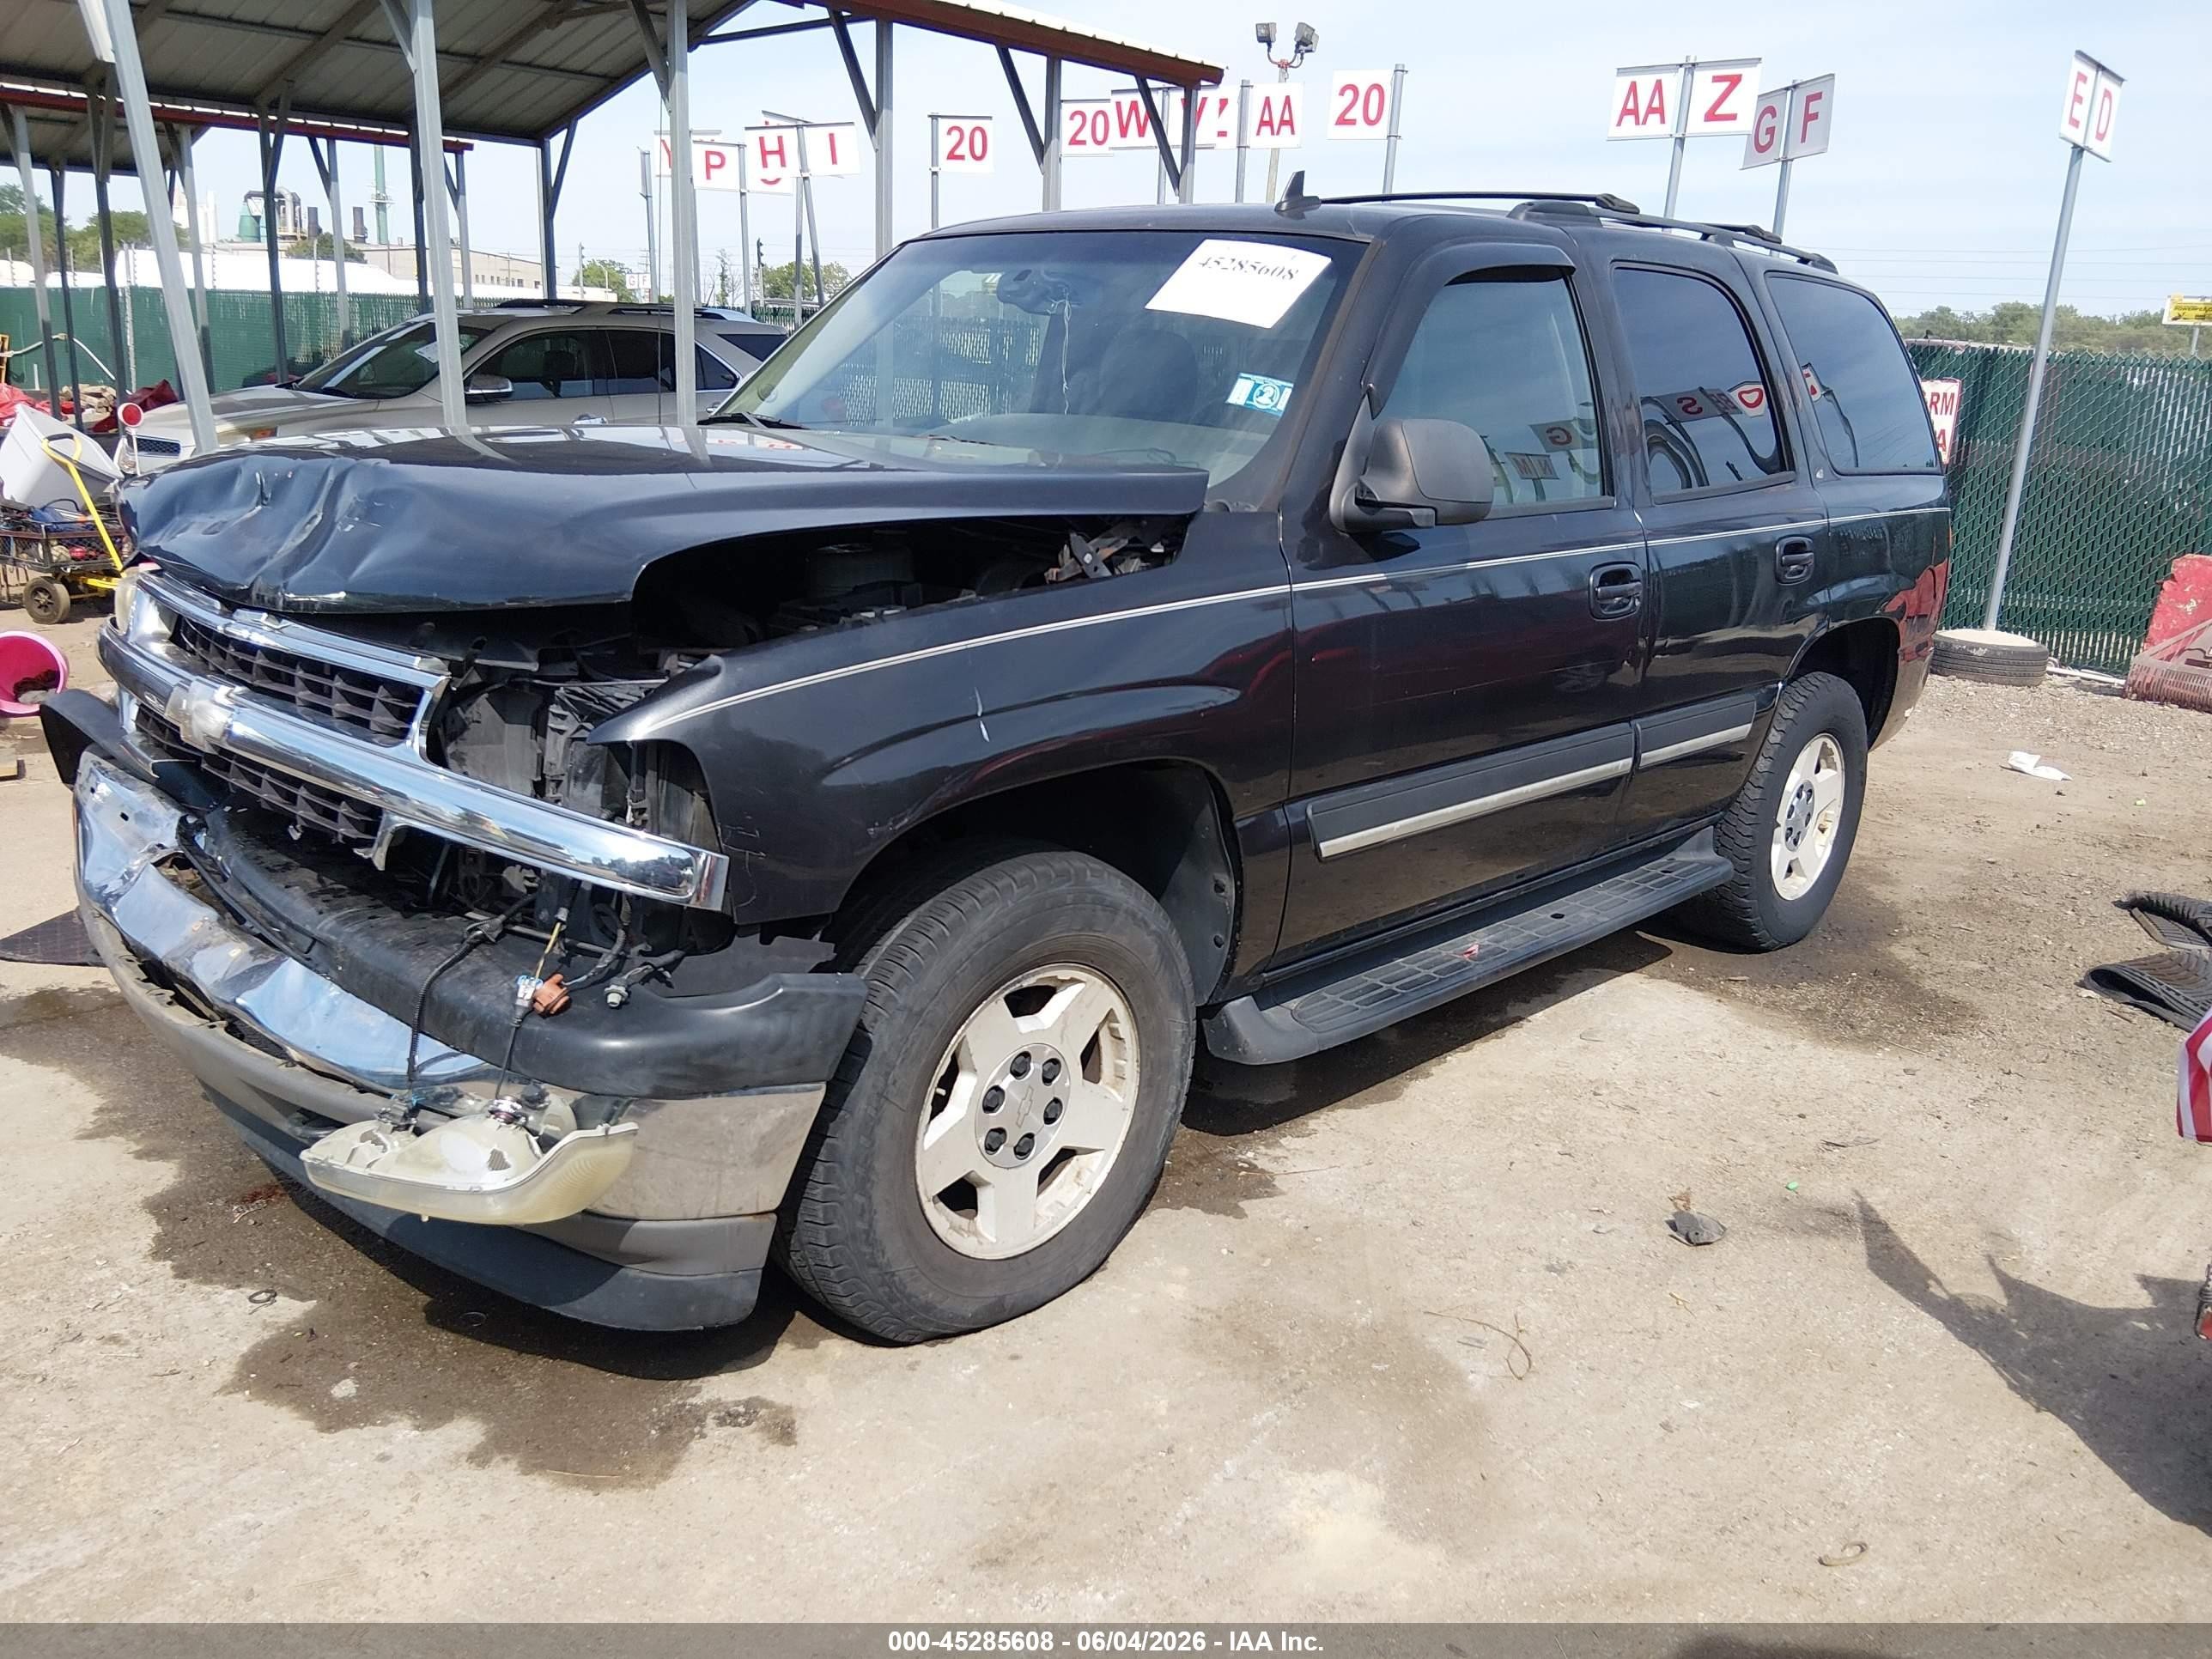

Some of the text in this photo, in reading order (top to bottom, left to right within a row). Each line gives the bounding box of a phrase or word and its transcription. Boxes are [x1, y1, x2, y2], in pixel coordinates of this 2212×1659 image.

[1115, 100, 1151, 138] W
[1255, 94, 1295, 136] AA
[1334, 83, 1385, 125] 20
[1616, 74, 1742, 127] AA Z
[2069, 70, 2112, 142] E D
[1068, 110, 1109, 145] 20
[1753, 91, 1823, 154] G F
[758, 132, 838, 168] H I
[946, 125, 988, 161] 20
[705, 150, 726, 180] P
[1923, 392, 1954, 416] RM
